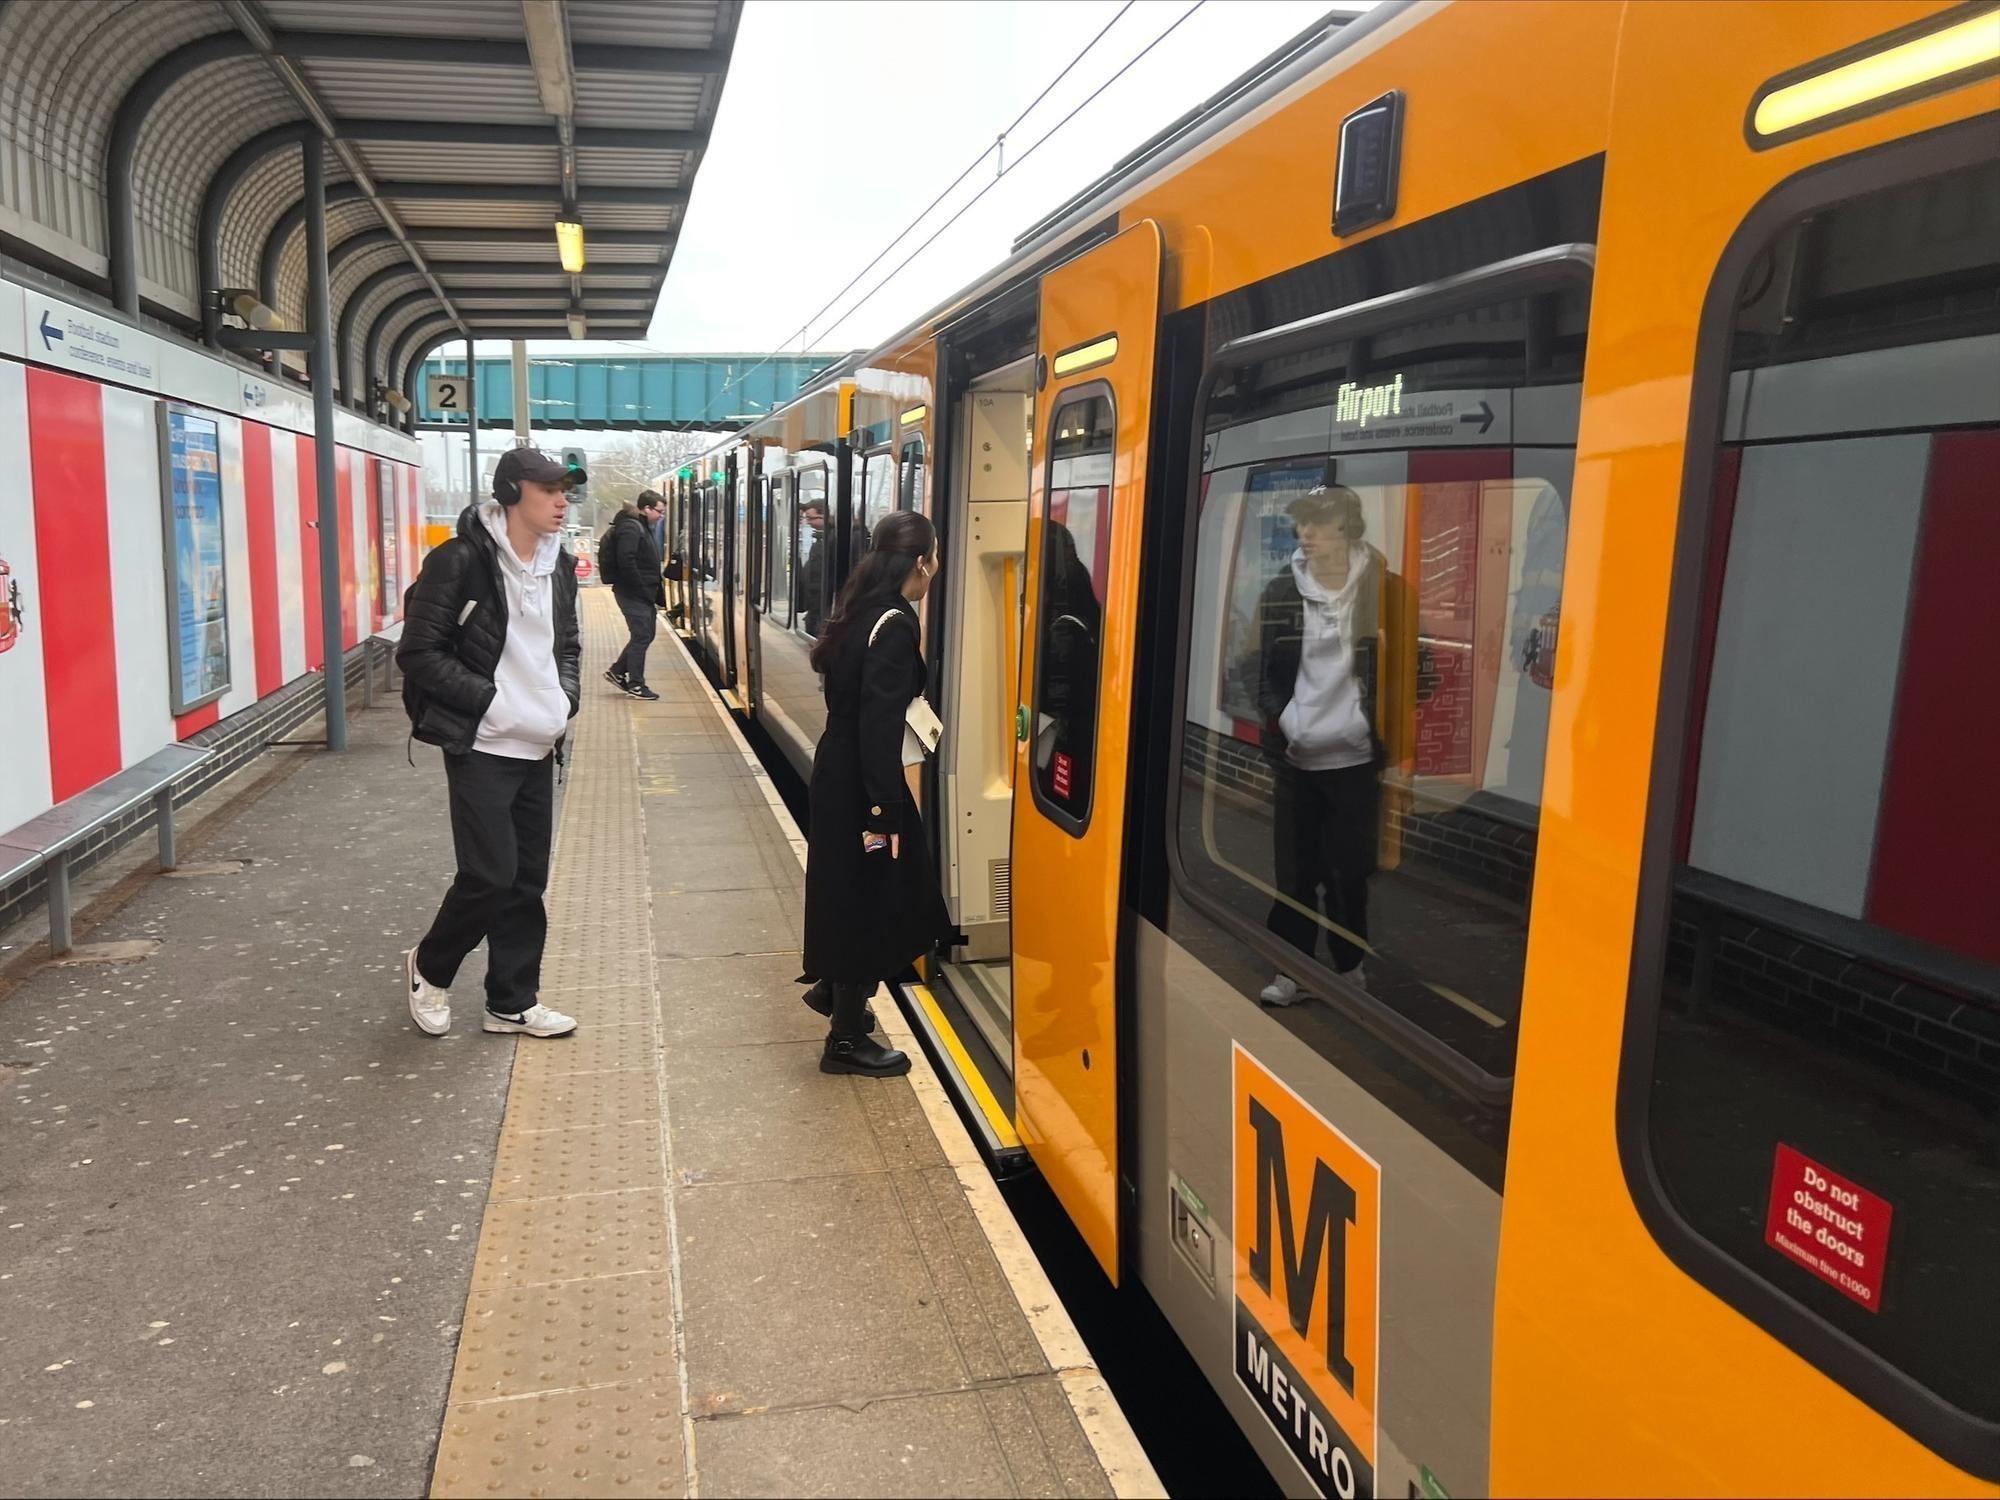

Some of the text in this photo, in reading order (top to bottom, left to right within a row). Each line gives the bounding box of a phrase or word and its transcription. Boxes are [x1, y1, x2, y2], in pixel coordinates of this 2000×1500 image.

[438, 383, 457, 408] 2
[1336, 373, 1403, 427] Airport
[1794, 1190, 1864, 1241] obstruct
[1804, 1166, 1860, 1212] Do not
[1249, 1094, 1356, 1400] M
[1786, 1207, 1865, 1267] the doors
[1775, 1232, 1871, 1300] Maximum fine £1000
[1247, 1330, 1356, 1499] METRO
